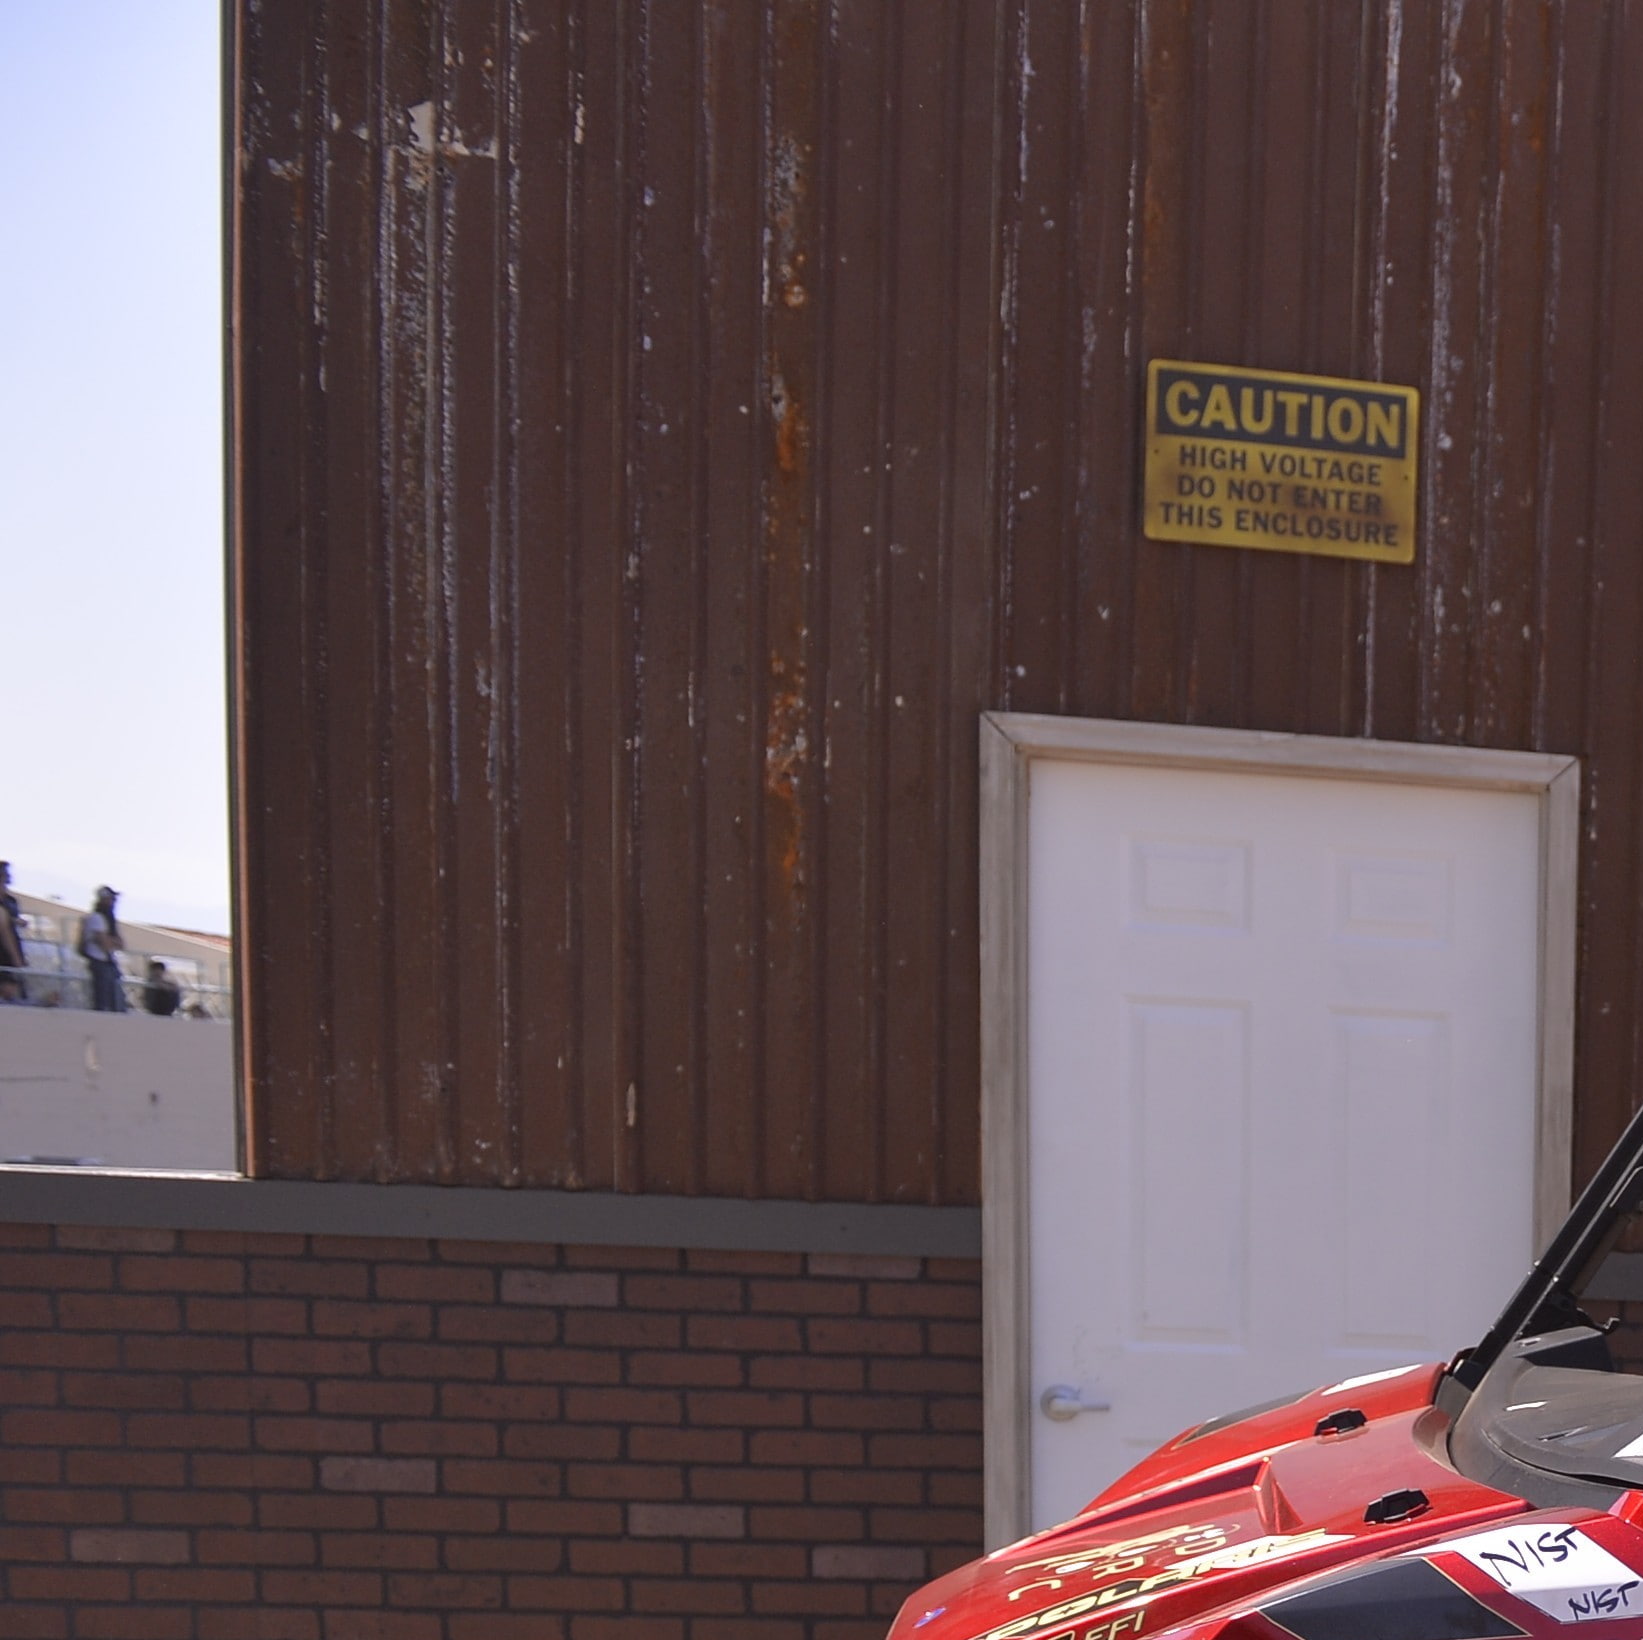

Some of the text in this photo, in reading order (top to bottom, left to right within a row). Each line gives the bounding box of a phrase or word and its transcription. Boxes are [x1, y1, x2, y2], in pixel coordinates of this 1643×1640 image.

[1164, 379, 1400, 449] CAUTION
[1179, 444, 1382, 487] HIGH VOLTAGE
[1176, 475, 1383, 516] DO NOT ENTER
[1159, 501, 1399, 547] THIS ENCLOSURE
[1479, 1526, 1578, 1586] NIST
[1568, 1580, 1640, 1621] NIST
